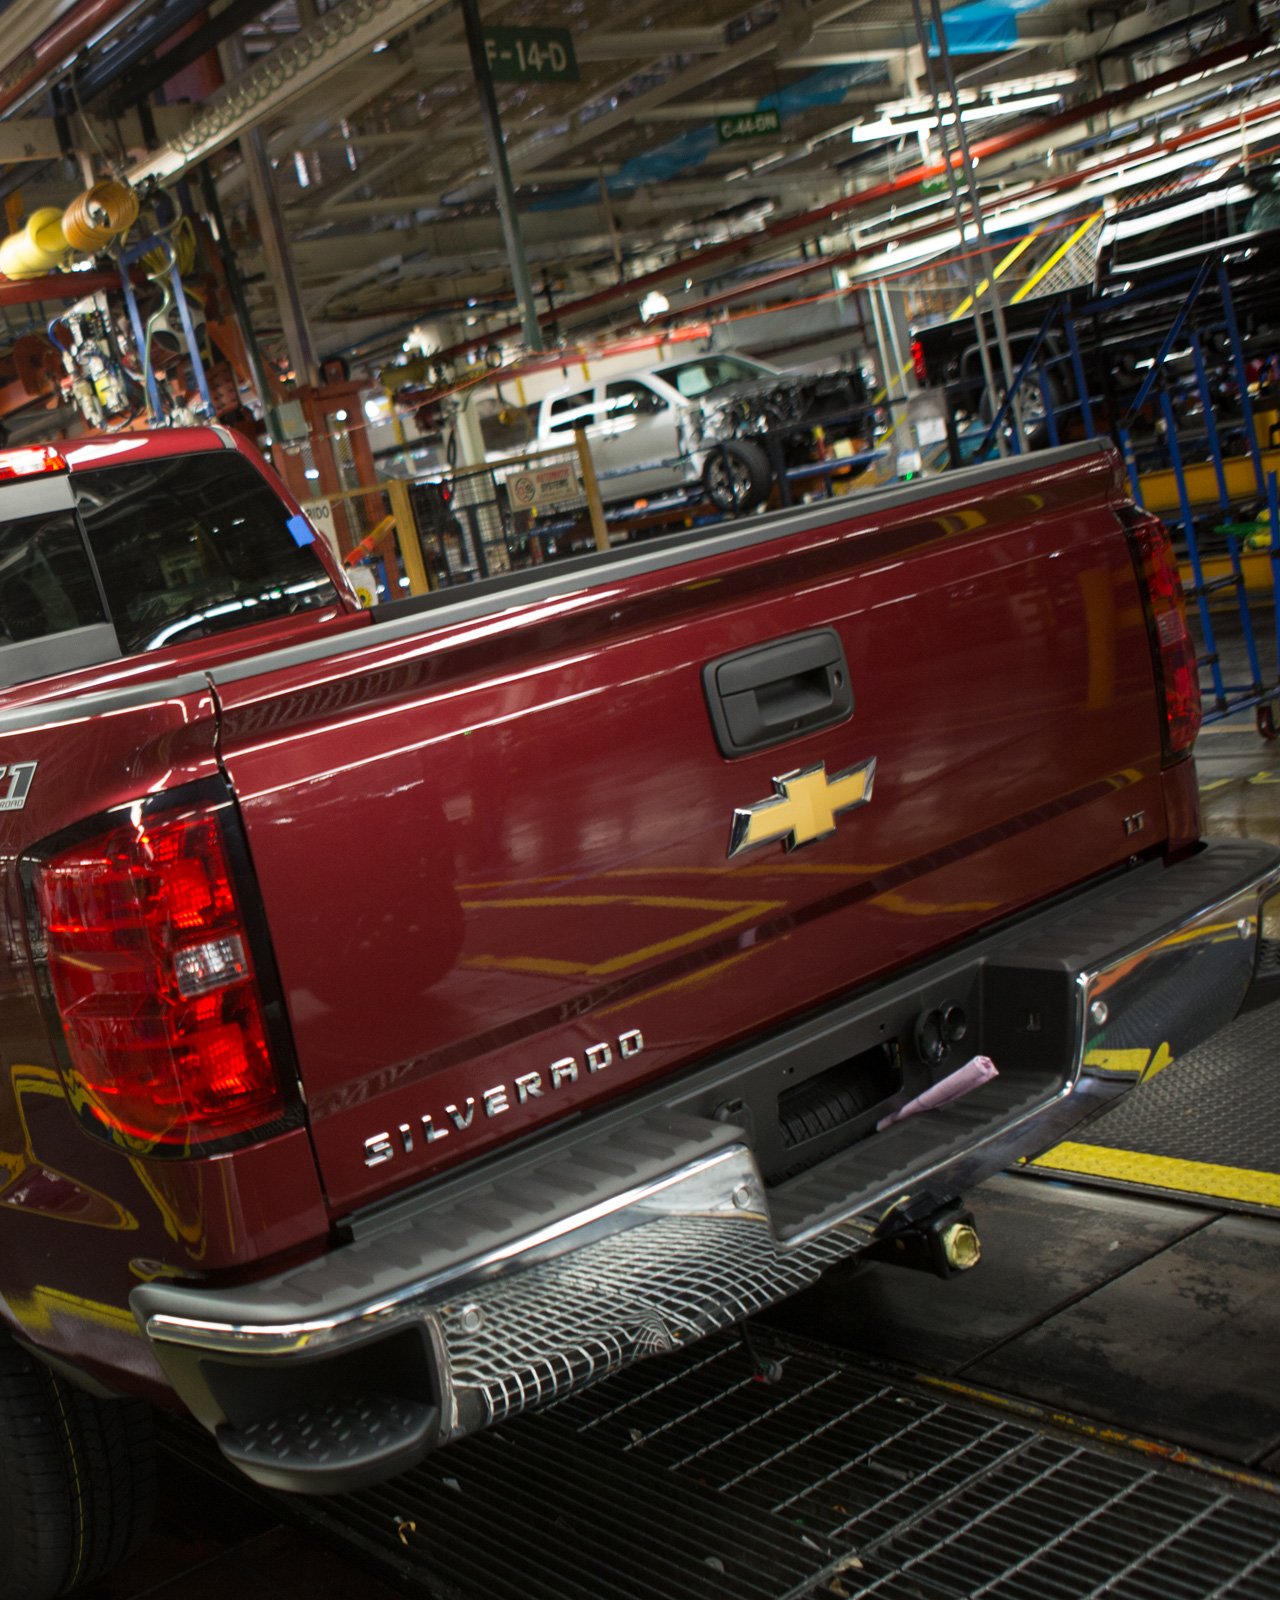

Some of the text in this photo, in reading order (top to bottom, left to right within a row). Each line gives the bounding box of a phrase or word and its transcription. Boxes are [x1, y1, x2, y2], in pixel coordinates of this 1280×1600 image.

[483, 38, 568, 72] F-14-D
[0, 798, 24, 809] ROAD
[1123, 810, 1145, 836] LT
[364, 1028, 644, 1167] SILVERADO
